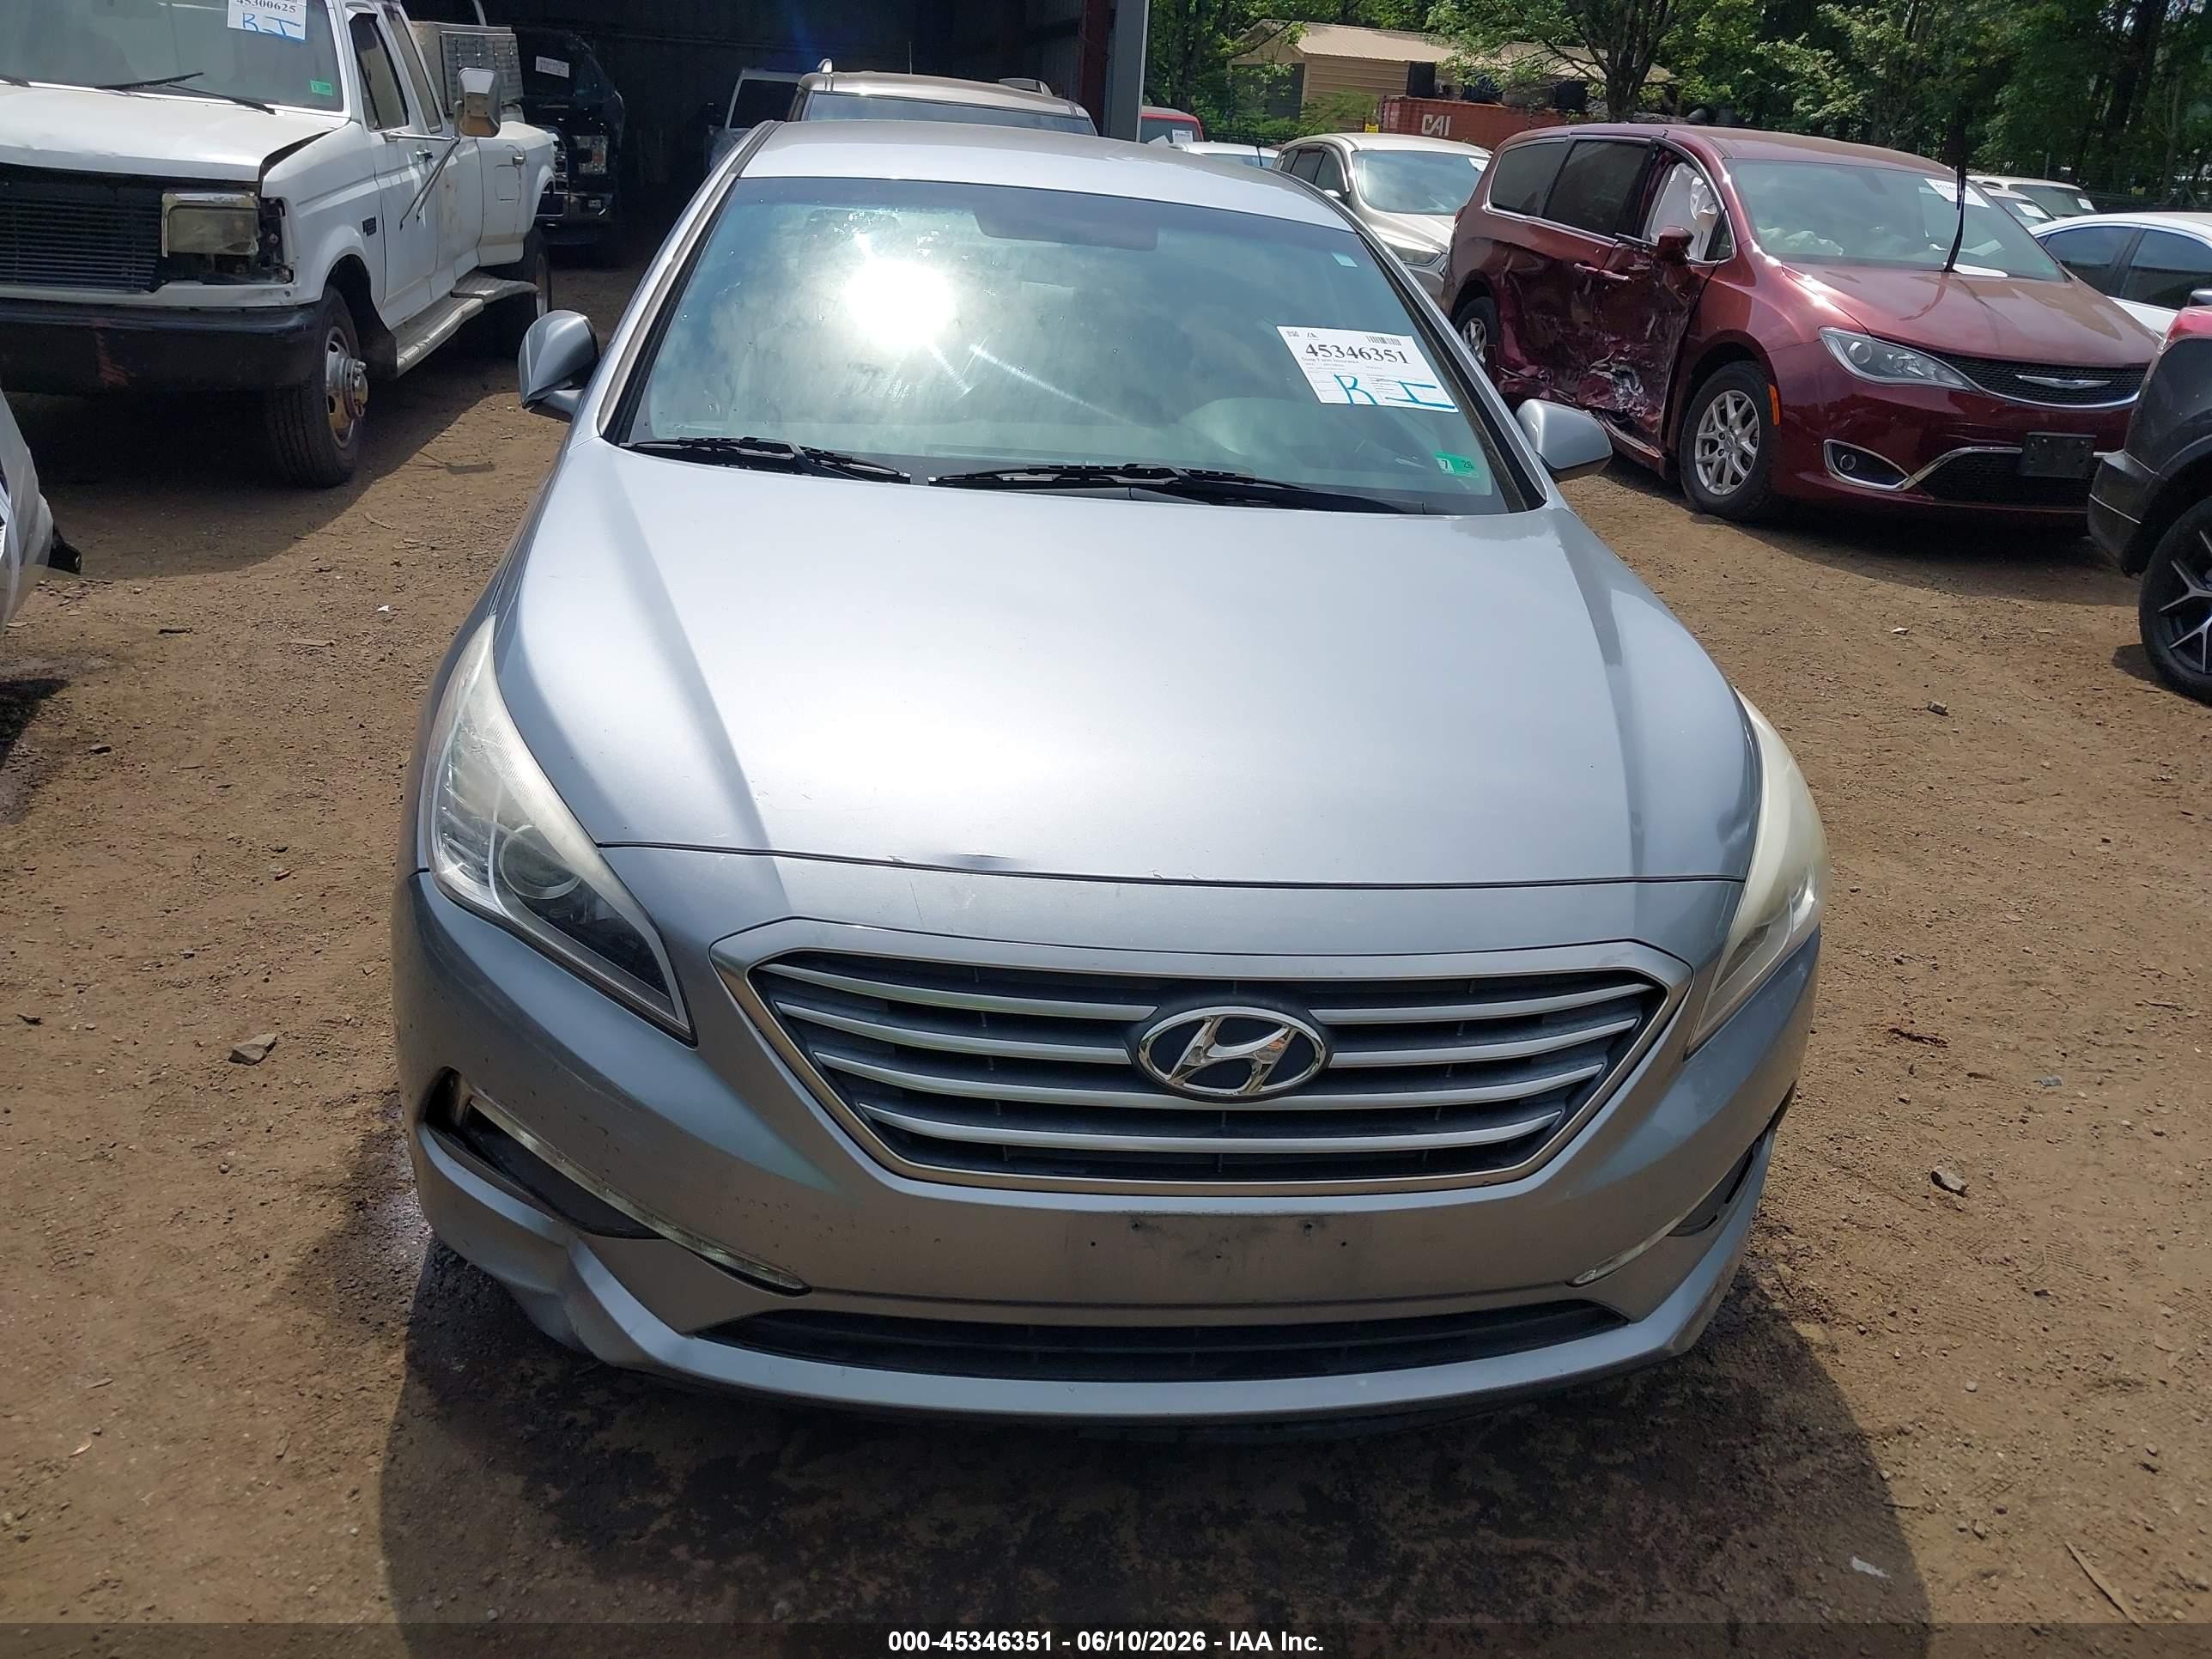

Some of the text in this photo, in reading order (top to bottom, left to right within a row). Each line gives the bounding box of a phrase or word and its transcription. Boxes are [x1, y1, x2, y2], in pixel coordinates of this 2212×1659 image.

[1421, 114, 1451, 137] CAI
[1305, 343, 1411, 364] 45346351
[1441, 459, 1449, 470] 7
